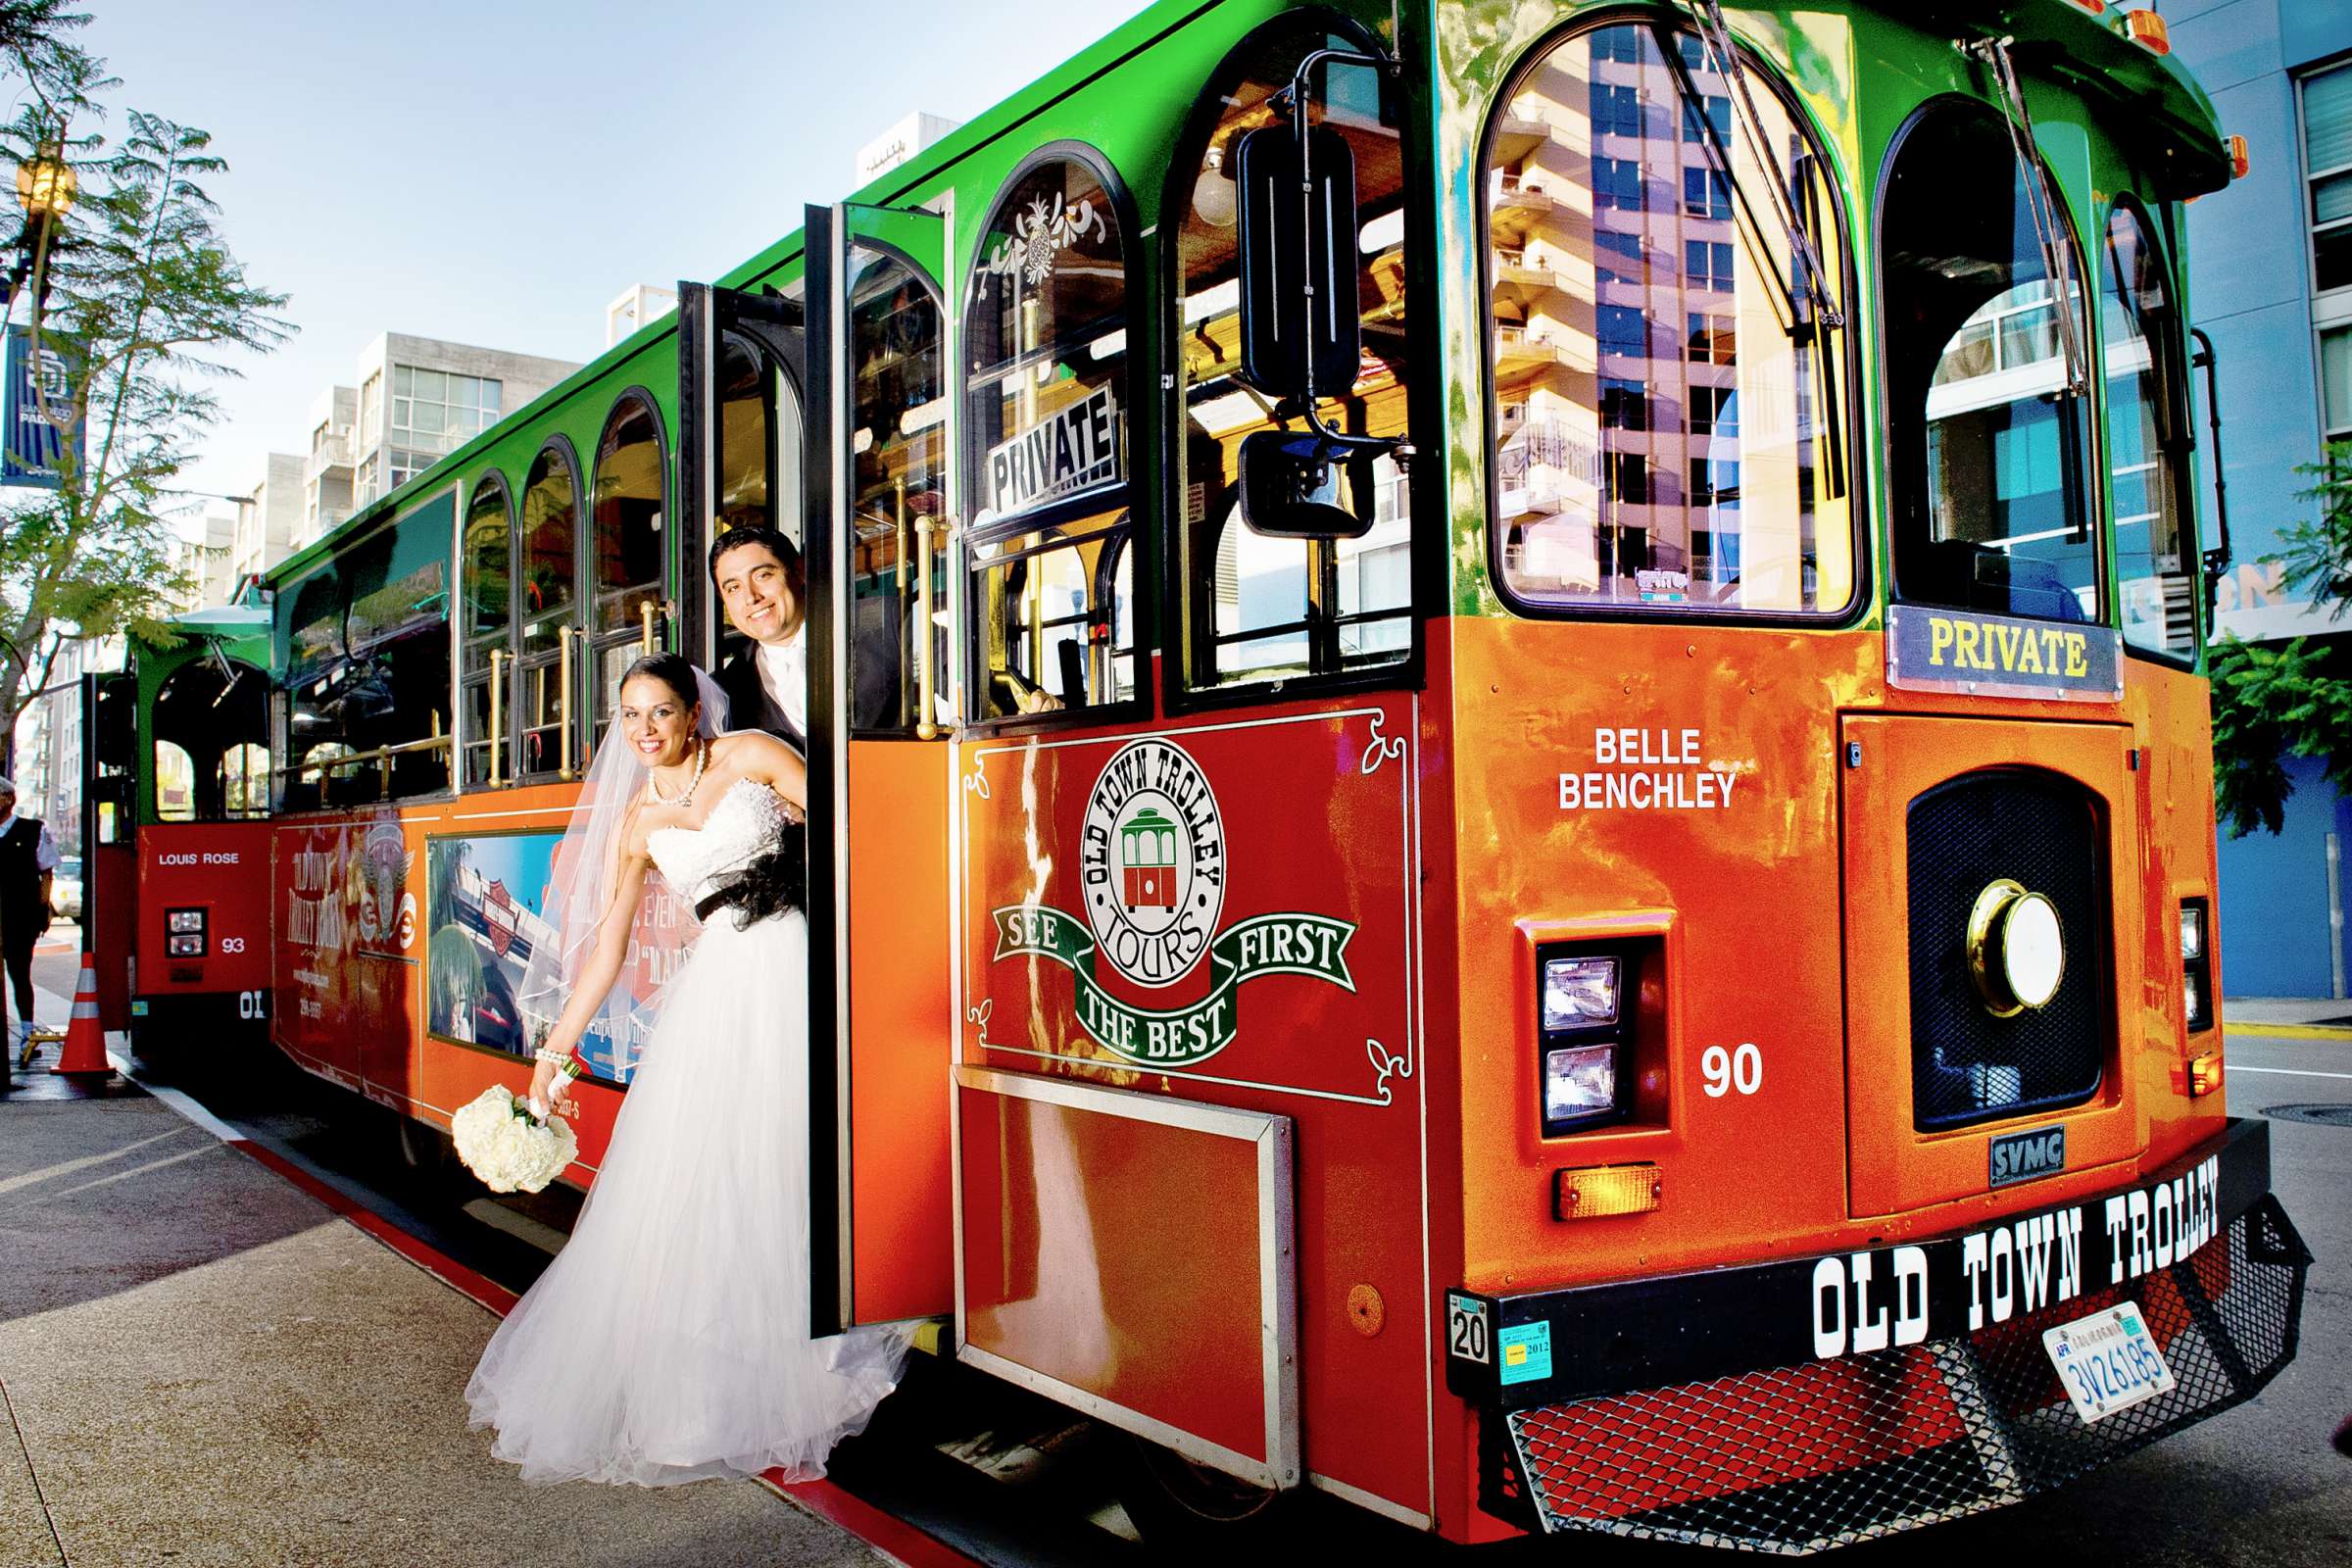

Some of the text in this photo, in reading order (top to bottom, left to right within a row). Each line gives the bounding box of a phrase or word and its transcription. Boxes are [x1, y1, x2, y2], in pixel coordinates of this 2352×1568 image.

[993, 390, 1112, 514] PRIVATE
[1929, 616, 2088, 677] PRIVATE
[1595, 727, 1701, 764] BELLE
[1558, 771, 1738, 810] BENCHLEY
[1086, 748, 1221, 888] OLD TOWN TROLLEY
[159, 853, 239, 865] LOUIS ROSE
[221, 937, 245, 954] 93
[1007, 912, 1059, 950] SEE
[1103, 904, 1205, 978] TOURS
[1240, 925, 1340, 971] FIRST
[239, 991, 266, 1019] OL
[1083, 985, 1227, 1058] THE BEST
[1701, 1043, 1763, 1098] 90
[1994, 1133, 2062, 1177] SVMC
[1811, 1154, 2220, 1360] OLD TOWN TROLLEY
[1453, 1311, 1486, 1359] 20
[1527, 1341, 1549, 1355] 2012
[2057, 1342, 2072, 1358] APR
[2068, 1337, 2163, 1404] 3V26185
